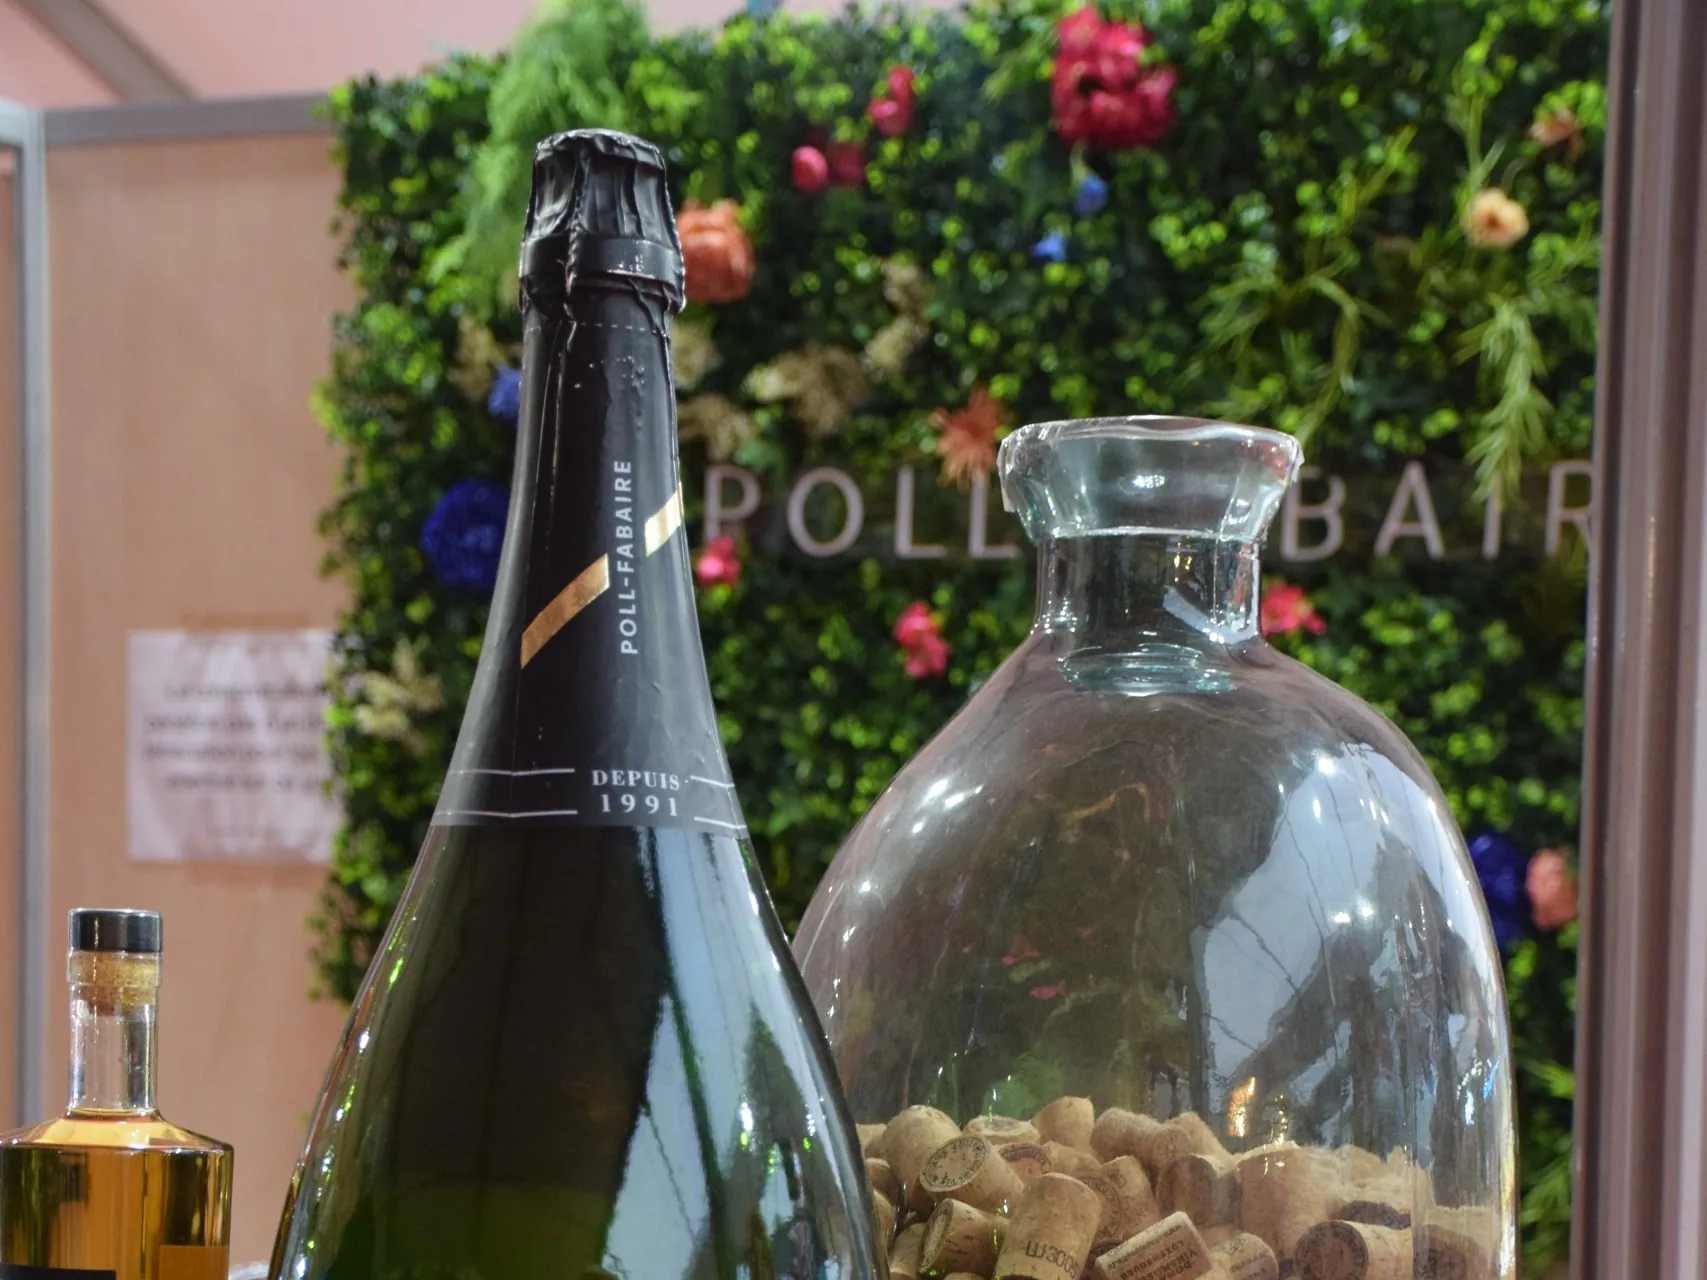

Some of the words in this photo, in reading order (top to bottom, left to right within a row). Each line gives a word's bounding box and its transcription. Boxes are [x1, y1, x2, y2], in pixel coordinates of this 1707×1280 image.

[614, 460, 638, 654] POLL-FABAIRE
[592, 769, 680, 791] DEPUIS
[601, 794, 679, 817] 1991
